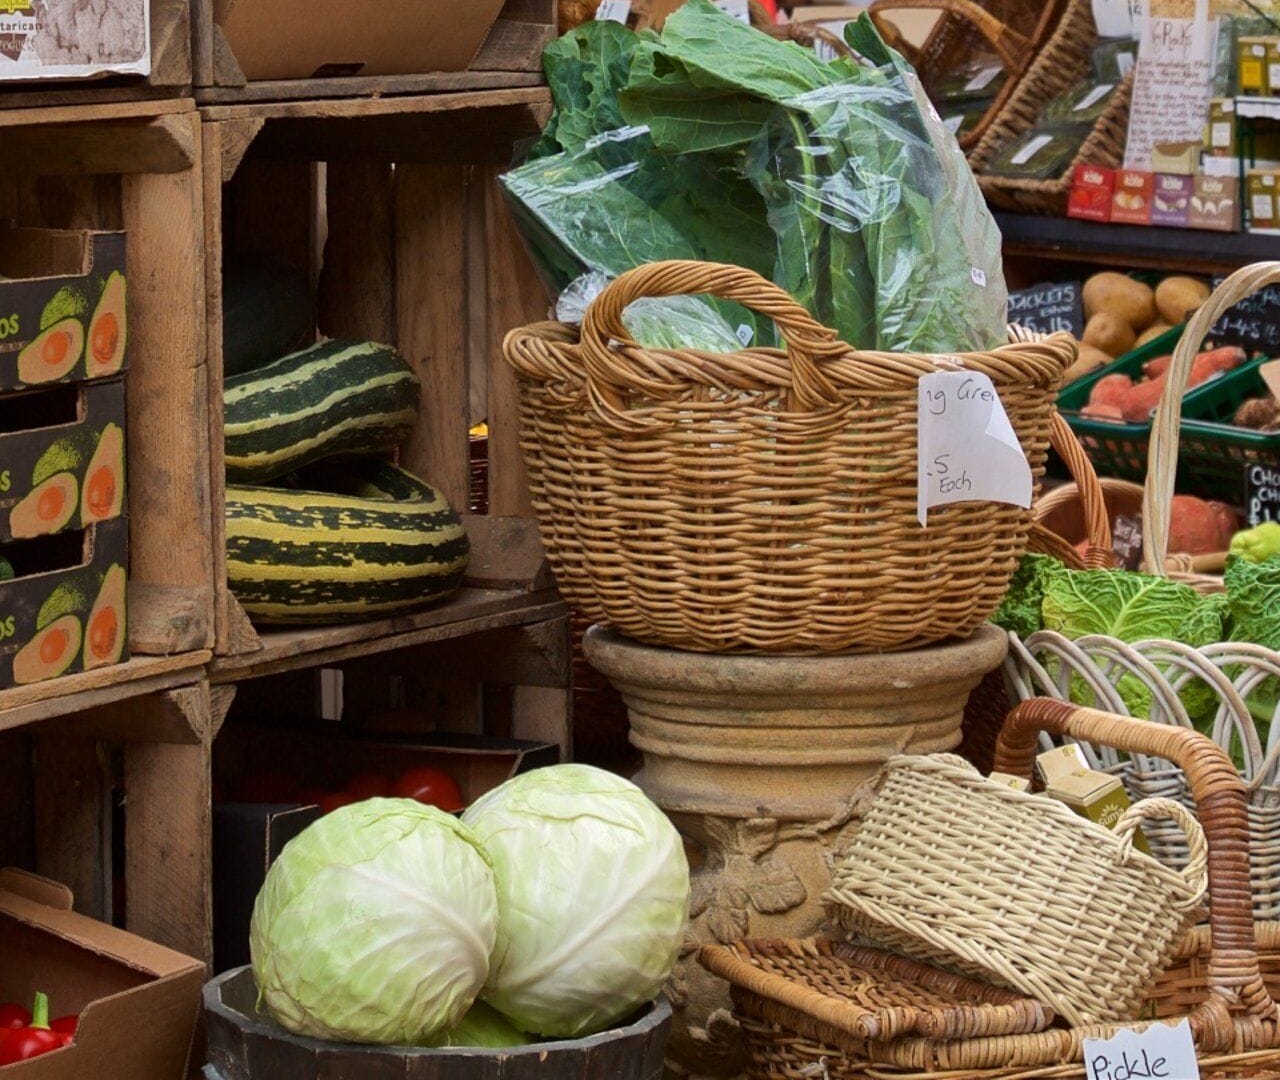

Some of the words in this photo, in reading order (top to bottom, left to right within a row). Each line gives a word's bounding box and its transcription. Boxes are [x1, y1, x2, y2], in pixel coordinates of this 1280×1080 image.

[1008, 285, 1075, 312] JACKETS
[940, 470, 972, 494] Each
[1092, 1049, 1170, 1080] Pickle
